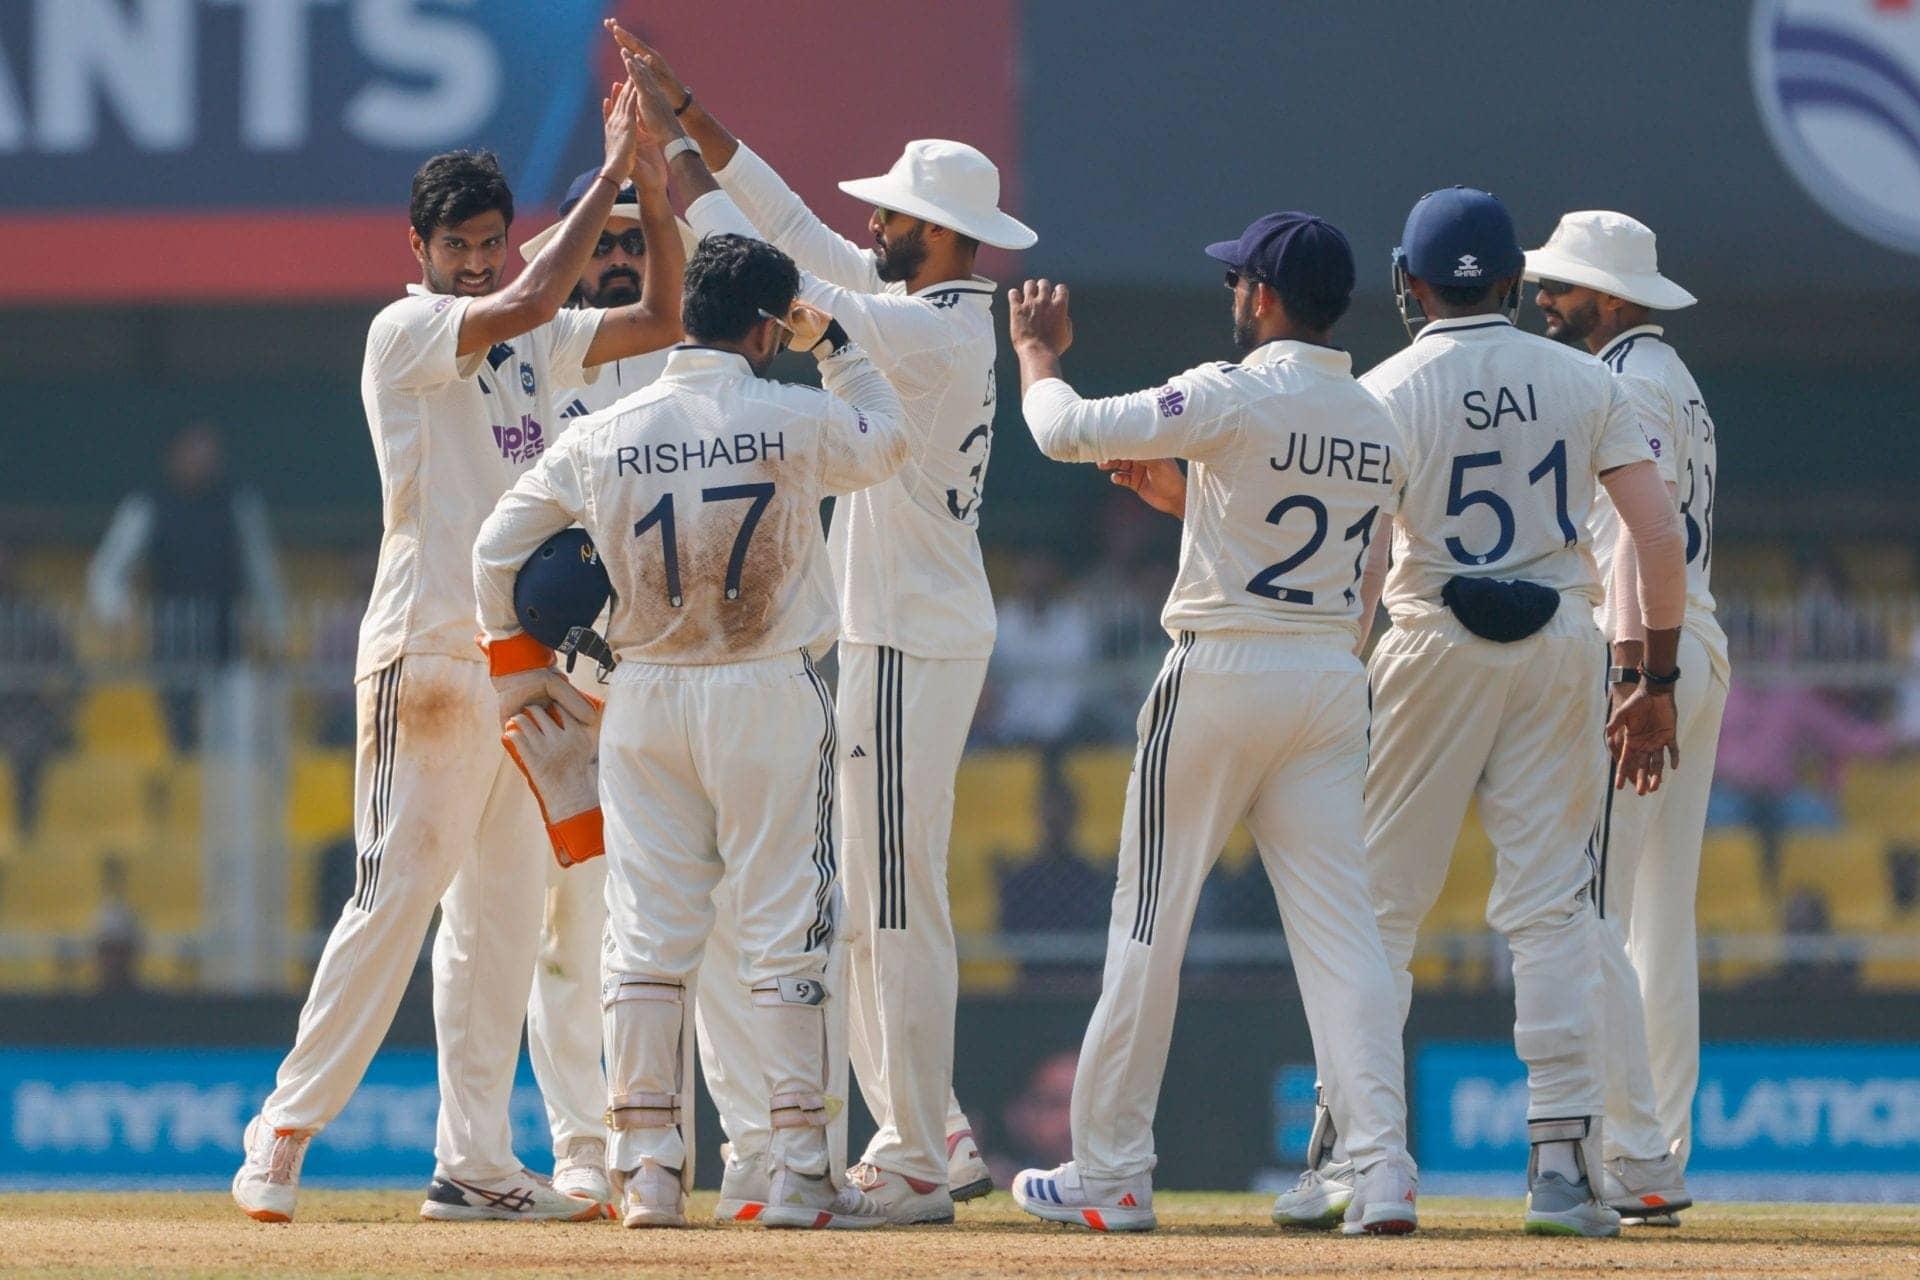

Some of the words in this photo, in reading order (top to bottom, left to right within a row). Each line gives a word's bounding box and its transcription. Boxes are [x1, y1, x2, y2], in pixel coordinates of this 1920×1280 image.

[1463, 383, 1537, 431] SAI
[617, 431, 785, 477] RISHABH
[1270, 432, 1393, 485] JUREL
[1445, 439, 1578, 566] 51
[634, 482, 776, 607] 17
[1245, 494, 1380, 607] 21
